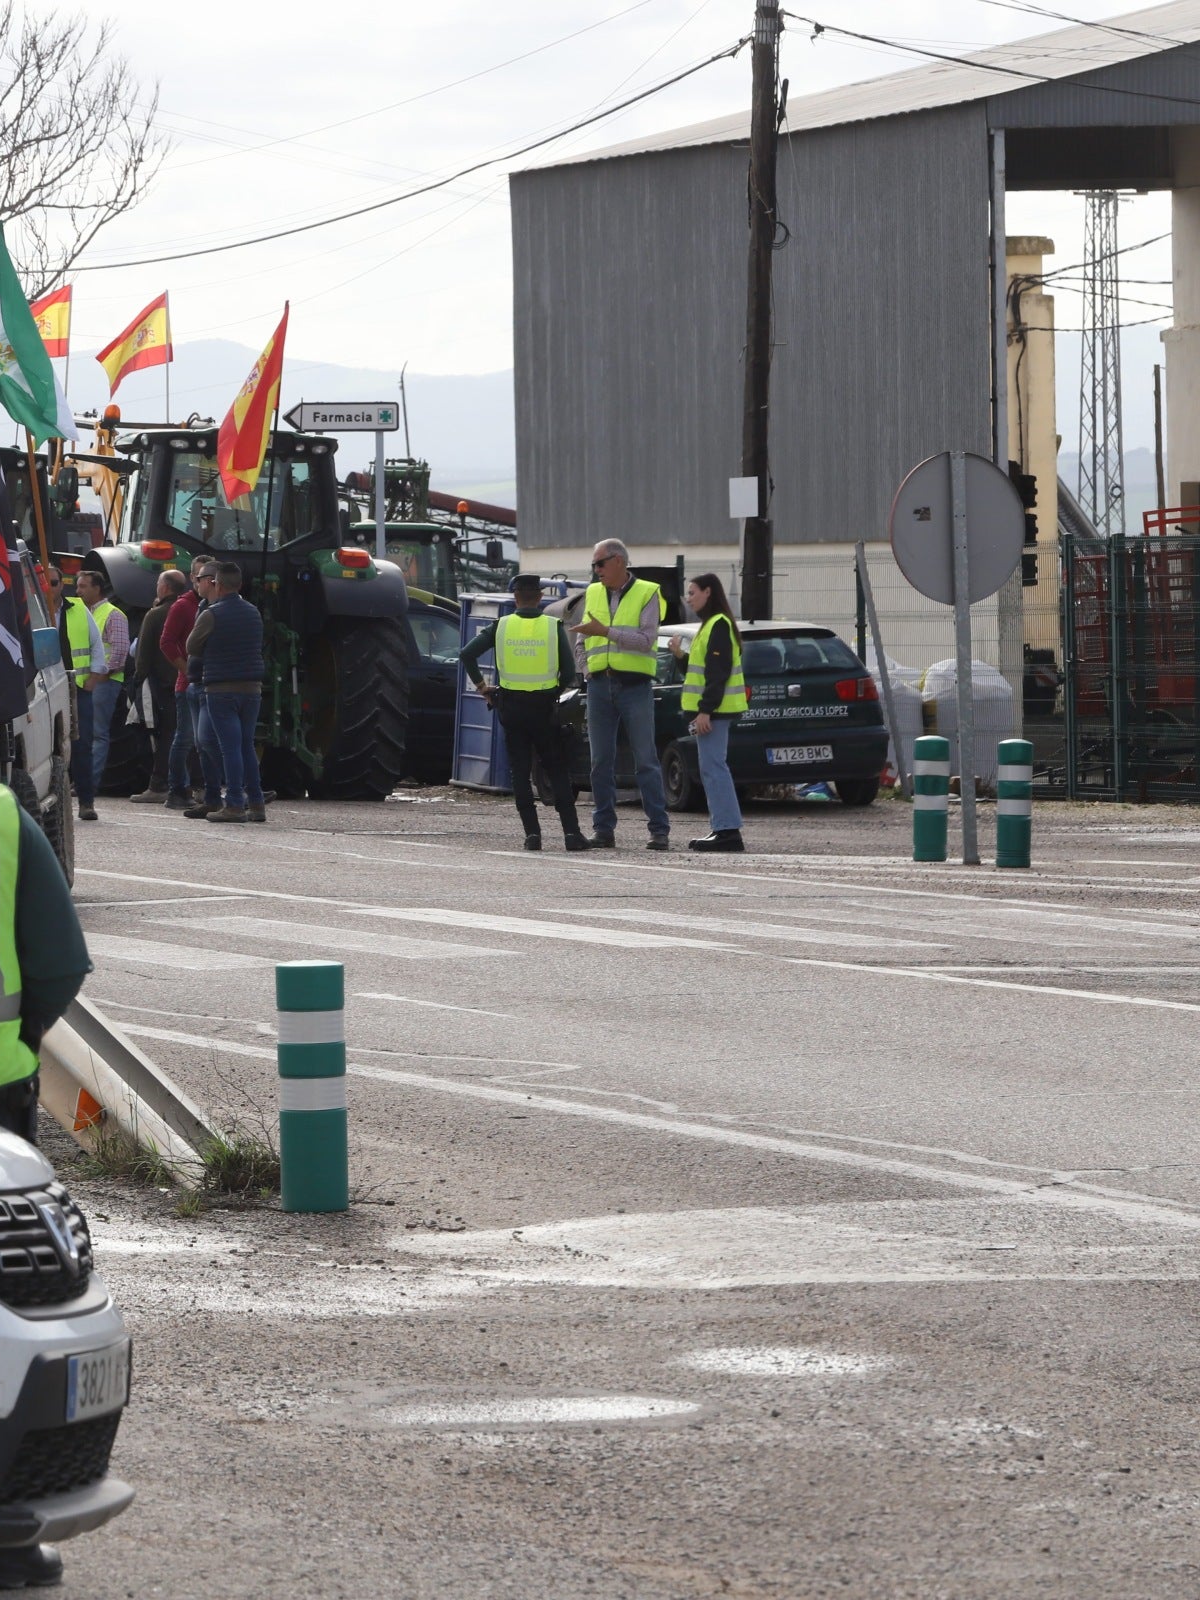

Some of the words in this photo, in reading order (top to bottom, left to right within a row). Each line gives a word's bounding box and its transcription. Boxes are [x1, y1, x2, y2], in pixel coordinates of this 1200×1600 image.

[312, 412, 373, 423] Farmacia
[505, 639, 545, 647] GUARDIA
[512, 648, 538, 657] CIVIL
[782, 706, 825, 718] AGRICOLAS
[825, 705, 849, 716] LOPEZ
[775, 748, 805, 761] 4128
[806, 747, 830, 759] BMC
